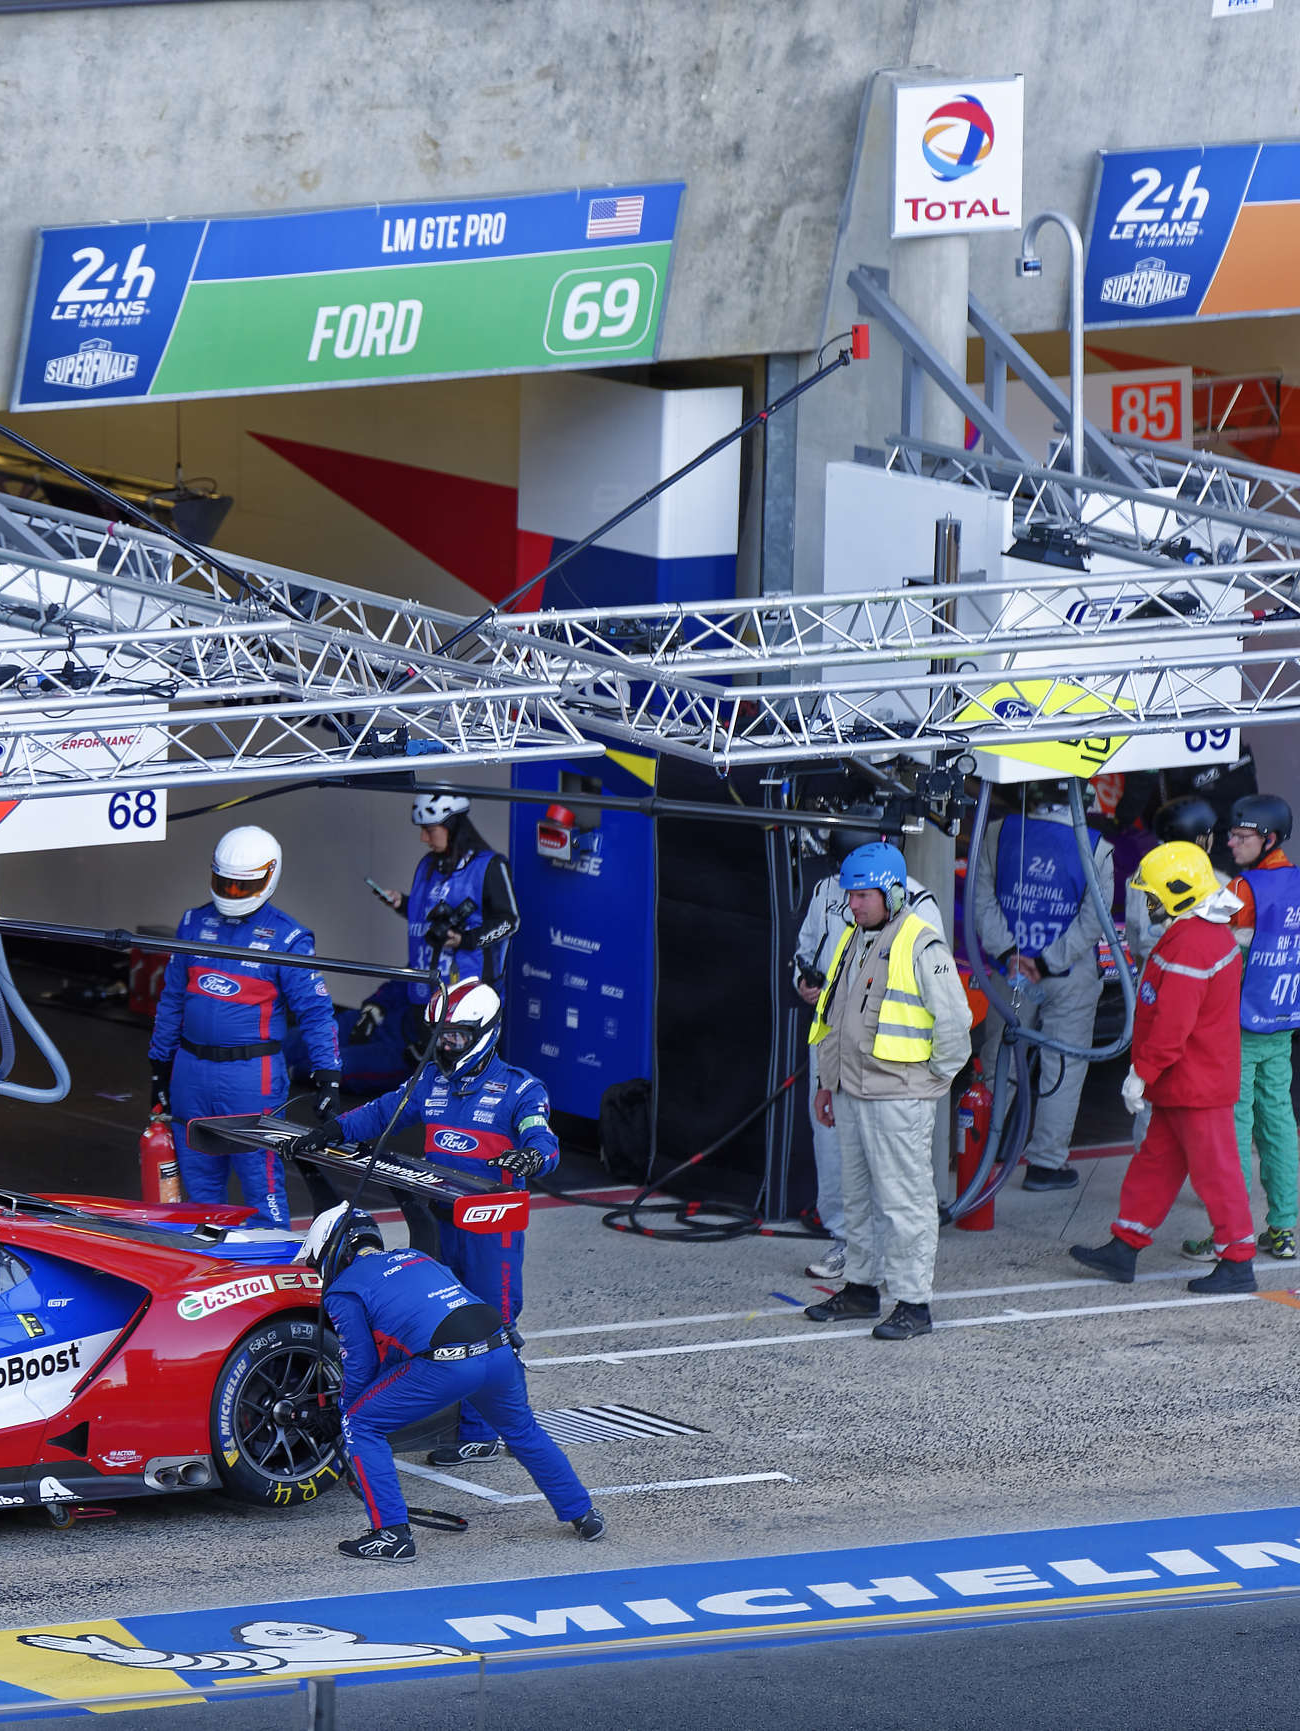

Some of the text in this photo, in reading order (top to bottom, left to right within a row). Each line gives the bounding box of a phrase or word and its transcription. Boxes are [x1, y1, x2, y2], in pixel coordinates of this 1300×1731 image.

[904, 197, 1010, 222] TOTAL
[381, 211, 507, 253] LM GTE PRO
[1109, 220, 1200, 240] LE MANS
[1103, 268, 1189, 307] SUPERFINALE
[51, 300, 146, 321] LE MANS
[561, 277, 640, 342] 69
[307, 299, 423, 362] FORD
[45, 348, 138, 388] SUPERFINALE
[1119, 384, 1175, 439] 85
[108, 790, 157, 830] 68
[1013, 880, 1064, 902] MARSHAL
[1014, 920, 1062, 951] 867
[203, 976, 231, 995] Ford
[440, 1132, 468, 1150] Ford
[266, 1193, 284, 1222] FORD
[462, 1202, 524, 1223] GT
[203, 1278, 269, 1310] Castrol
[221, 1359, 248, 1436] MICHELIN
[444, 1540, 1300, 1644] MICHELIN
